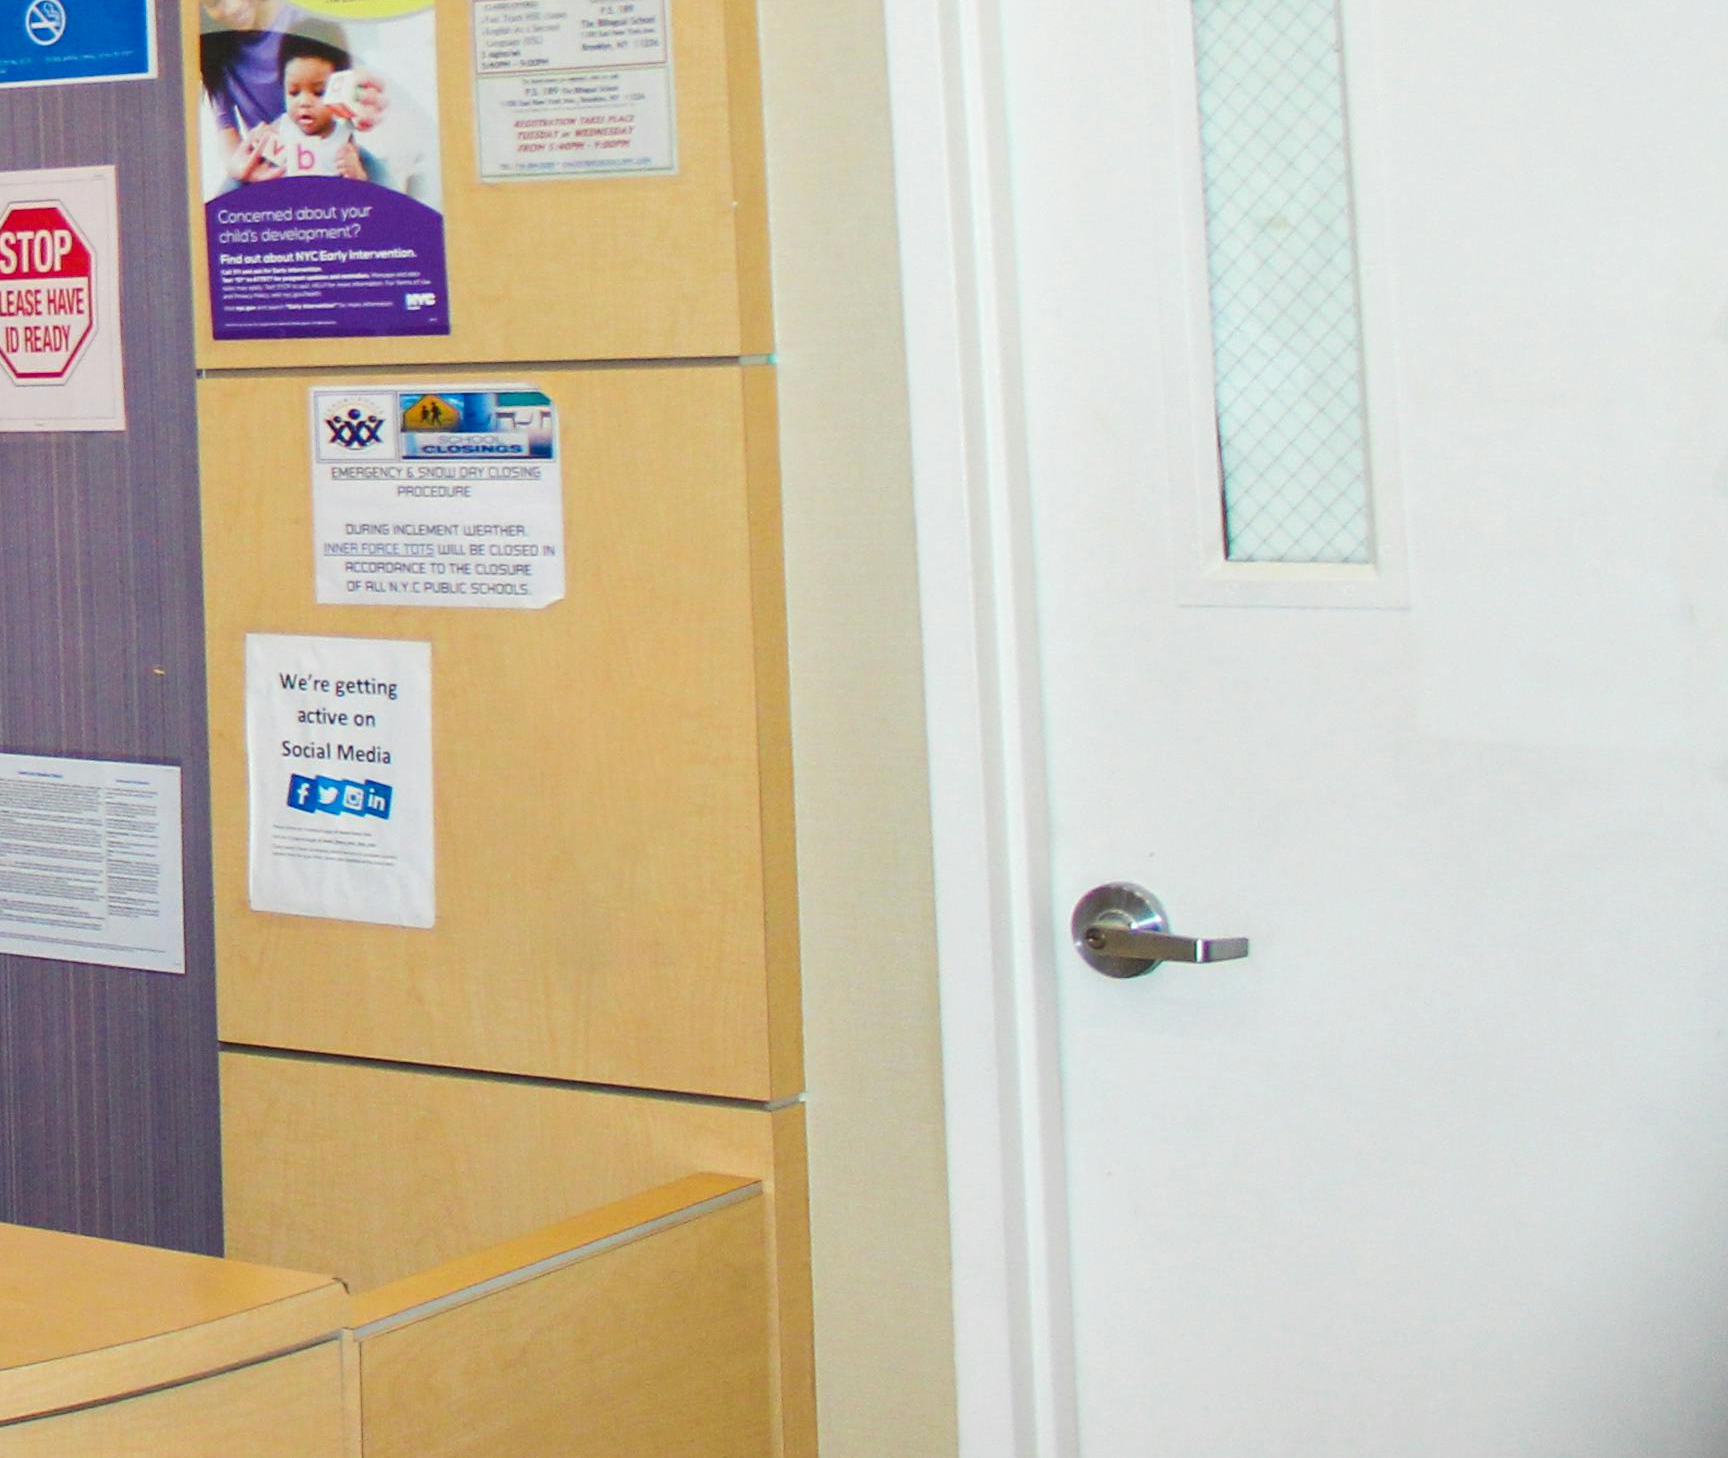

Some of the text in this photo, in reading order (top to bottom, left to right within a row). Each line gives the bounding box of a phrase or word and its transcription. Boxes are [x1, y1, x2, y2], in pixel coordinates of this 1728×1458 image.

[296, 142, 315, 170] b
[218, 207, 373, 224] Concerned about your
[219, 224, 362, 243] child's development?
[220, 247, 417, 265] Find out about NYC Early Intervention.
[47, 287, 85, 316] HAVE
[4, 325, 71, 353] ID READY
[439, 435, 500, 443] SCHOOL
[421, 444, 523, 454] CLOSINGS
[331, 467, 541, 479] EMERGENCY & SNOW DAY CLOSING
[397, 486, 471, 497] PROCEDURE
[345, 524, 390, 536] DURING
[394, 524, 459, 536] INCLEMENT
[323, 542, 555, 557] INNER FORCE TOTS WILL BE CLOSED IN
[345, 562, 532, 576] ACCORDANCE TO THE CLOSURE
[347, 580, 362, 592] OF
[365, 581, 387, 592] ALL
[424, 582, 467, 594] PUBLIC
[279, 672, 398, 700] We're getting
[297, 706, 376, 728] active on
[281, 740, 391, 765] Social Media
